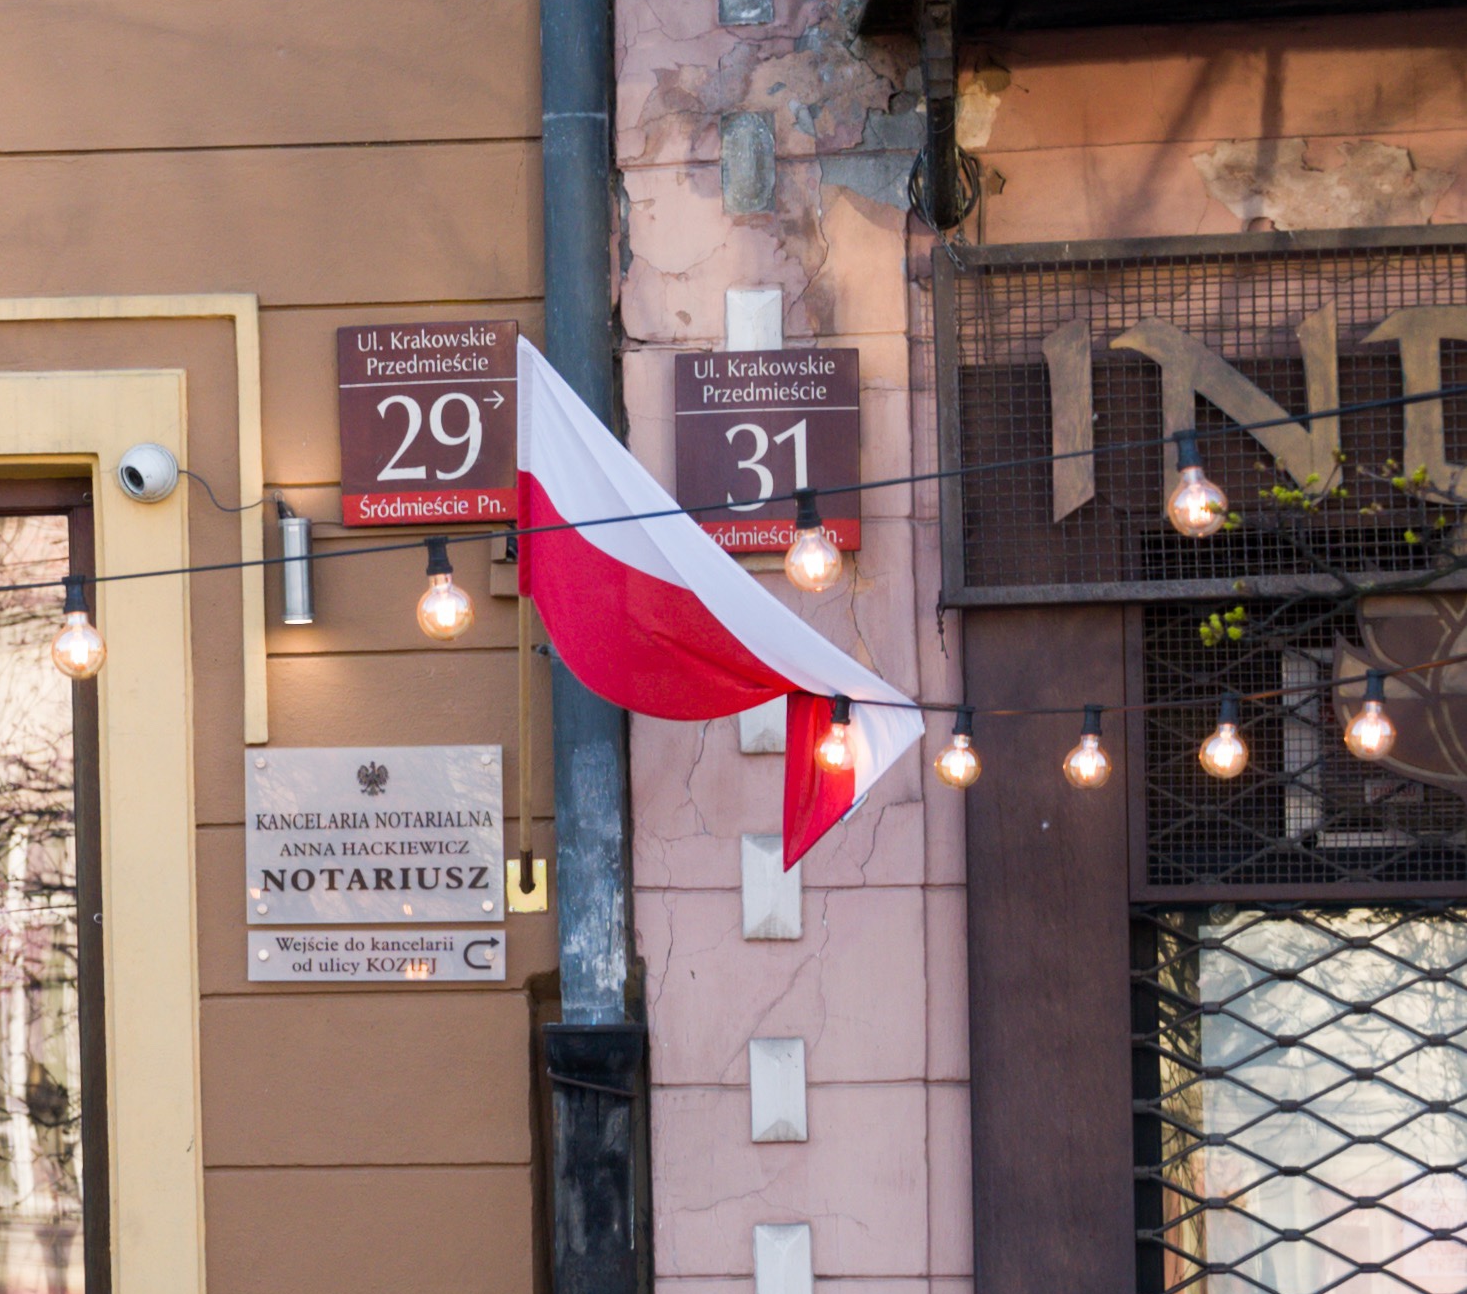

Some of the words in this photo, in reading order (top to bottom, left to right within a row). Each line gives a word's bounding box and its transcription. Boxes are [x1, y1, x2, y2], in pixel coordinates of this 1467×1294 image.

[358, 331, 383, 352] Ul.
[391, 327, 496, 351] Krakowskie
[367, 353, 489, 376] Przedmieście
[694, 358, 720, 380] Ul.
[728, 355, 836, 377] Krakowskie
[703, 381, 827, 404] Przedmieście
[377, 392, 483, 481] 29
[725, 418, 809, 512] 31
[360, 494, 469, 519] Śródmieście
[478, 494, 507, 514] Pn.
[256, 812, 370, 831] KANCELARIA
[375, 810, 494, 829] NOTARIALNA
[280, 842, 336, 857] ANNA
[342, 840, 470, 856] HACKIEWICZ
[261, 866, 490, 892] NOTARIUSZ
[275, 936, 339, 954] Wejście
[344, 936, 365, 952] do
[371, 936, 454, 952] kancelarii
[292, 958, 313, 973] od
[319, 957, 360, 976] ulicy
[366, 957, 438, 975] KOZIEJ
